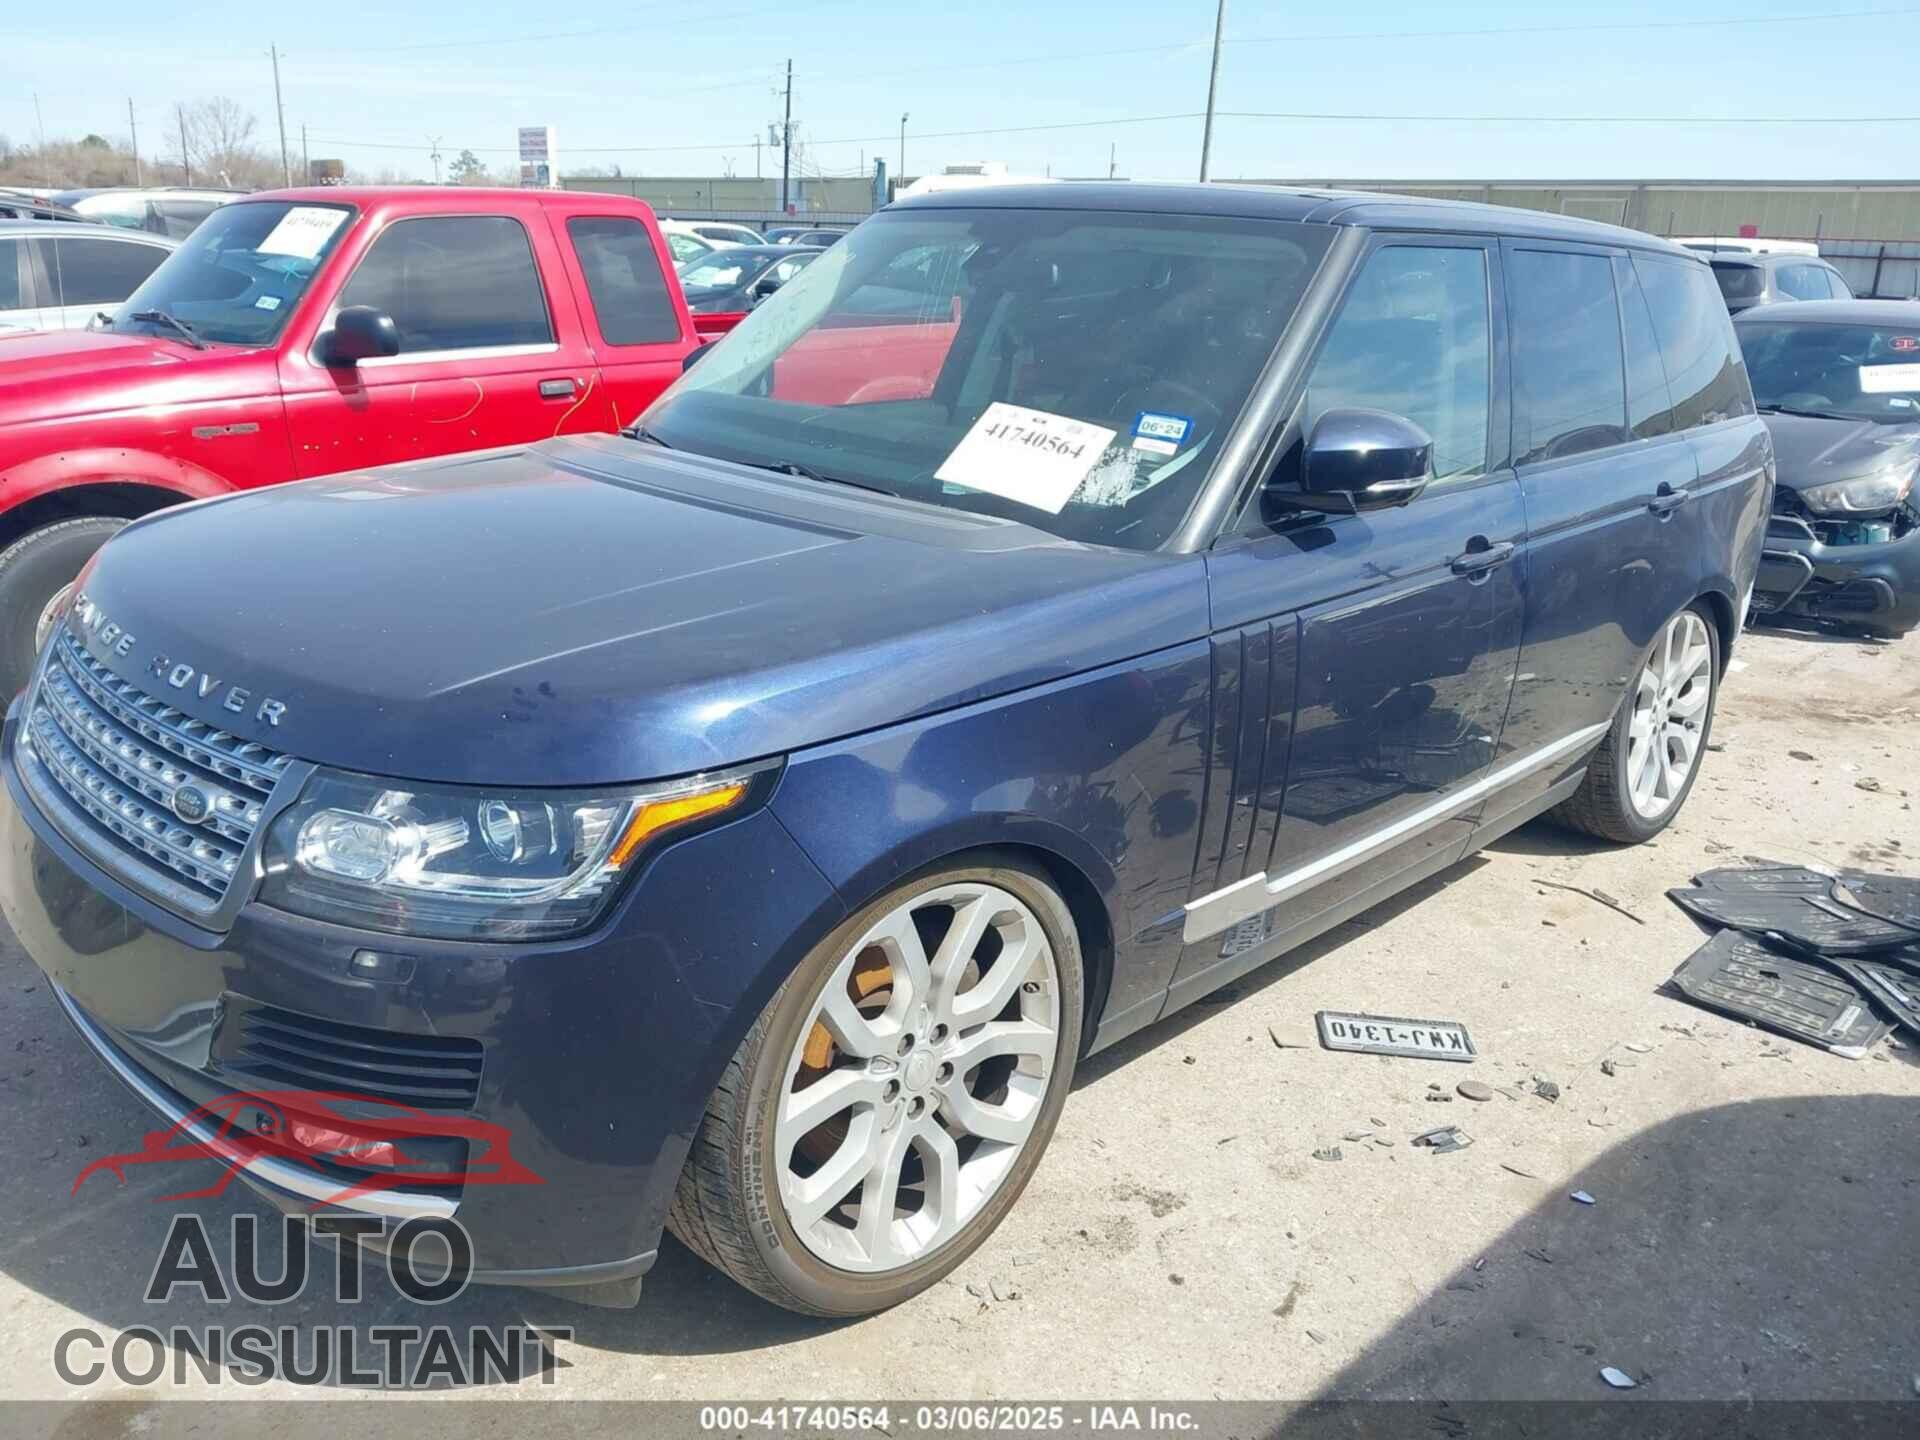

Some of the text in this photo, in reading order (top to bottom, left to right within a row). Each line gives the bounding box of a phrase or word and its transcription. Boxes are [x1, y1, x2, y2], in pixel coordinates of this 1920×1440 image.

[985, 424, 1086, 458] 41740564
[74, 591, 287, 725] RANGE ROVER
[1330, 1021, 1464, 1050] KWJ-1340
